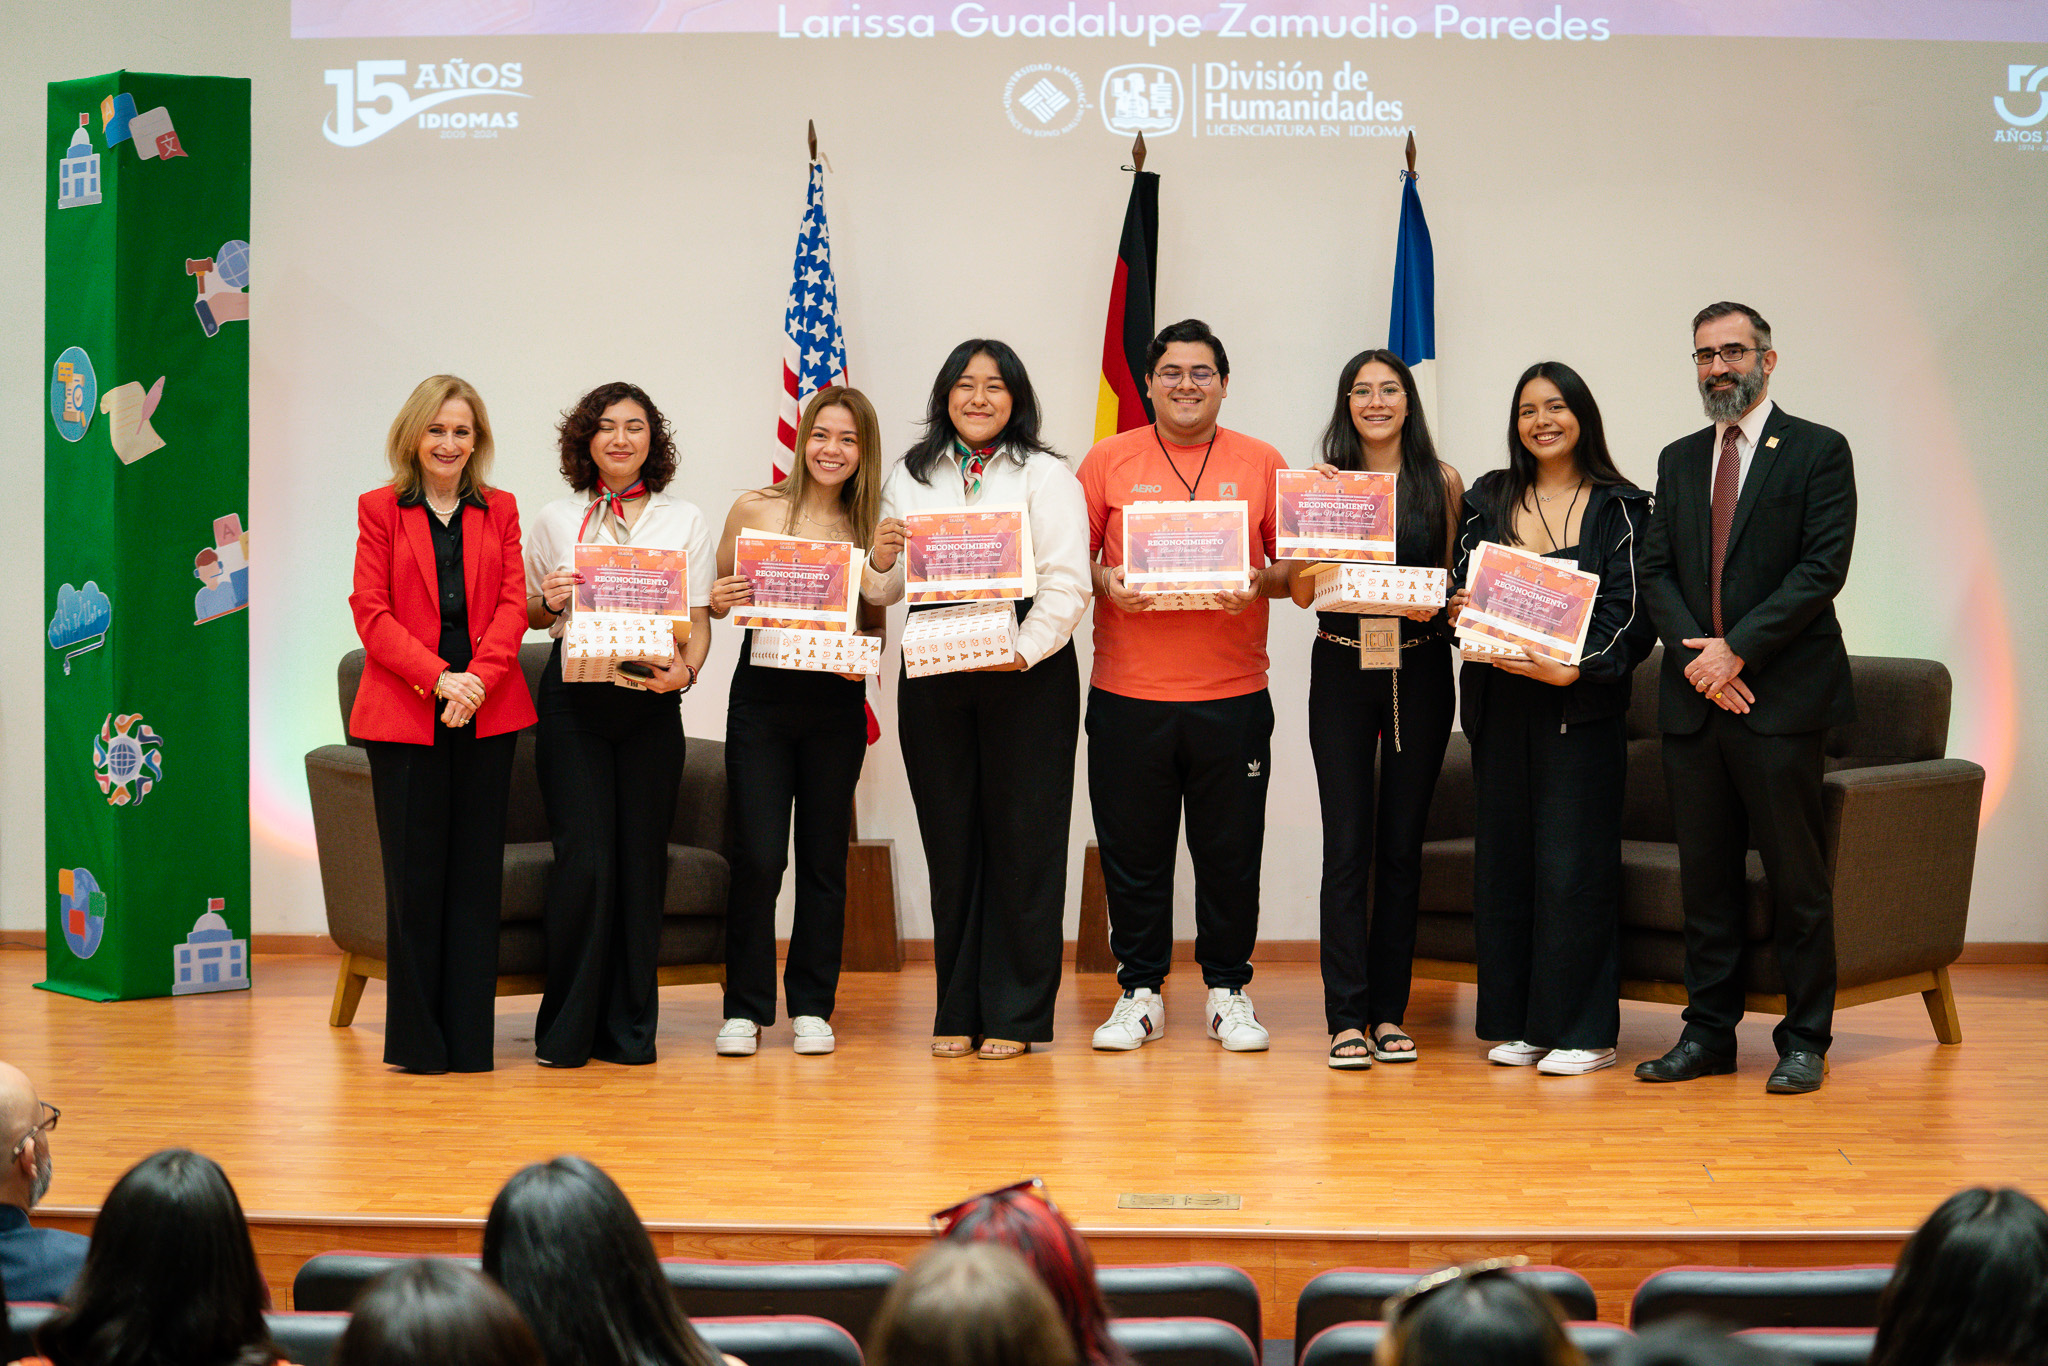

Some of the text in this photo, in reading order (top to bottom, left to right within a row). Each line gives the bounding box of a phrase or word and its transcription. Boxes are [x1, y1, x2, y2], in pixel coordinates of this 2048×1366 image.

[777, 0, 1611, 47] Larissa Guadalupe Zamudio Paredes
[413, 58, 524, 90] AÑOS
[1205, 60, 1368, 91] División de
[1003, 63, 1053, 104] UNIVERSIDAD
[323, 60, 410, 142] 15
[1205, 91, 1404, 122] Humanidades
[418, 112, 519, 129] IDIOMAS
[1206, 123, 1316, 137] LICENCIATURA
[1320, 124, 1341, 137] EN
[1994, 127, 2043, 143] AÑOS
[160, 135, 177, 157] 文
[1130, 483, 1162, 493] AERO
[1222, 485, 1234, 496] A
[1298, 501, 1375, 511] RECONOCIMIENTO
[223, 523, 236, 540] A
[925, 542, 1002, 551] RECONOCIMIENTO
[1147, 538, 1224, 547] RECONOCIMIENTO
[594, 575, 668, 586] RECONOCIMIENTO
[755, 569, 830, 580] RECONOCIMIENTO
[1494, 579, 1568, 610] RECONOCIMIENTO
[1365, 632, 1395, 647] ICON
